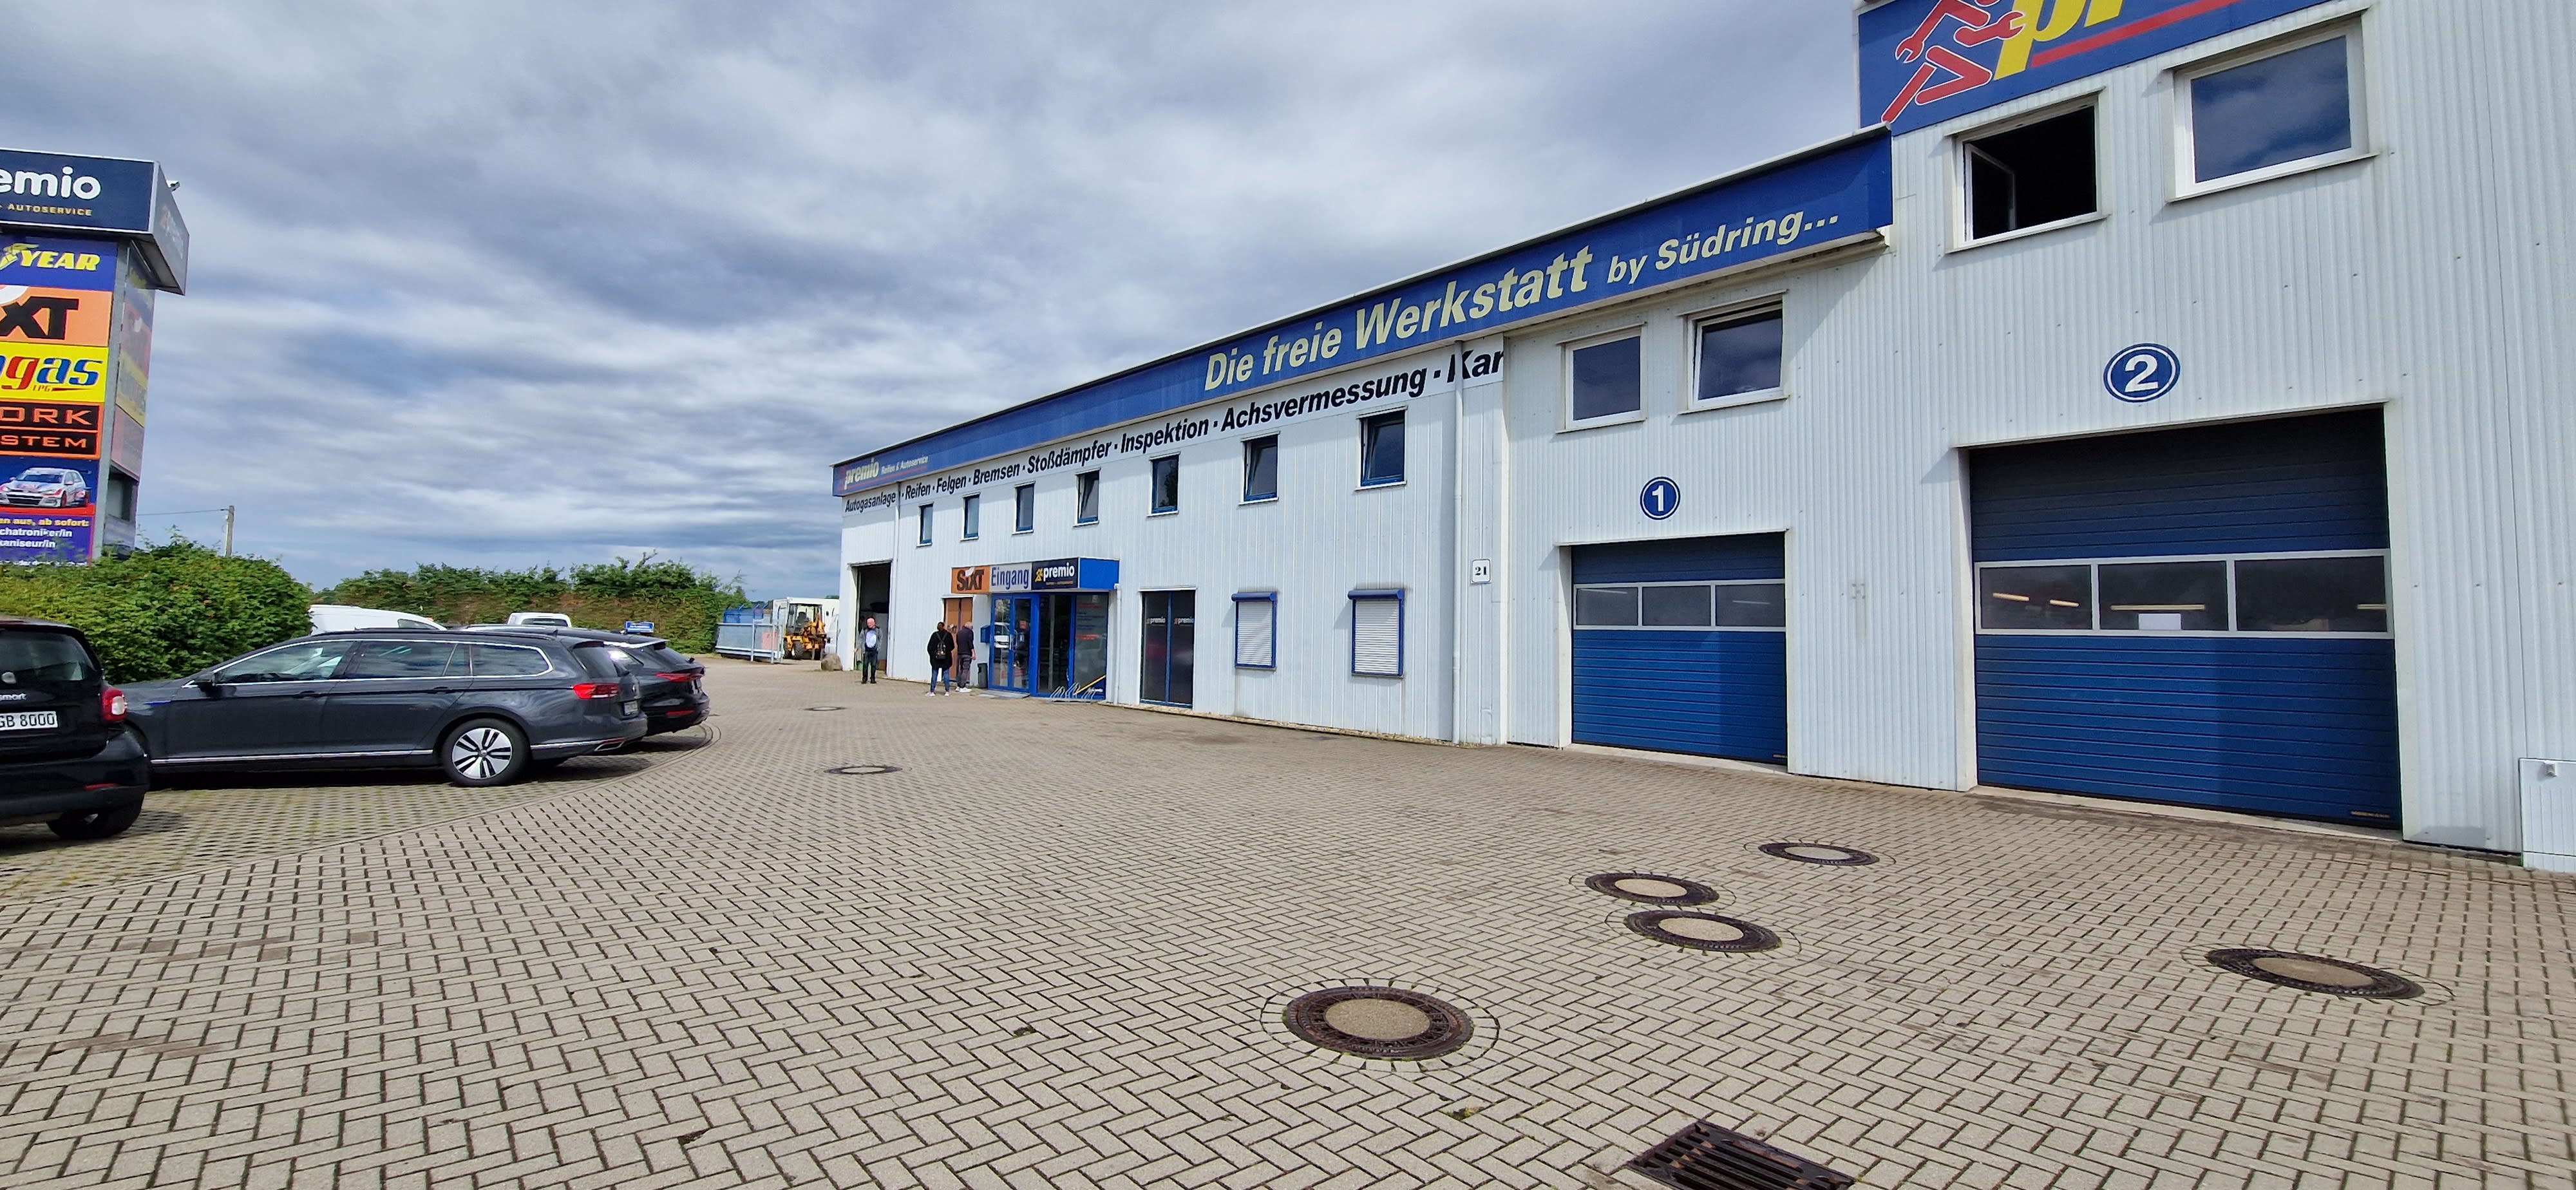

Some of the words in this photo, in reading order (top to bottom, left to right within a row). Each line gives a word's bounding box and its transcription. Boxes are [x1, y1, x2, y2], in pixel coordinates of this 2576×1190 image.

[8, 203, 93, 216] AUTOSERVICE
[21, 250, 100, 271] YEAR
[1204, 347, 1254, 391] Die
[1262, 321, 1343, 375] freie
[1356, 245, 1593, 350] Werkstatt
[1607, 255, 1647, 285] by
[1655, 211, 1839, 270] Südring...
[0, 355, 103, 390] gas
[2125, 354, 2159, 392] 2
[0, 406, 93, 426] ORK
[0, 435, 87, 448] STEM
[845, 491, 896, 513] Autogasanlage
[905, 482, 931, 500] Reifen
[936, 475, 967, 495] Felgen
[972, 462, 1020, 486] Bremsen
[1027, 441, 1112, 475] Stoßdämpfer
[1121, 419, 1209, 454] Inspektion
[1221, 367, 1427, 431] Achsvermessung
[844, 457, 880, 490] premio
[1652, 485, 1664, 512] 1
[991, 567, 1029, 590] Eingang
[1043, 562, 1075, 582] premio
[1475, 566, 1487, 576] 21
[20, 713, 55, 726] 8000
